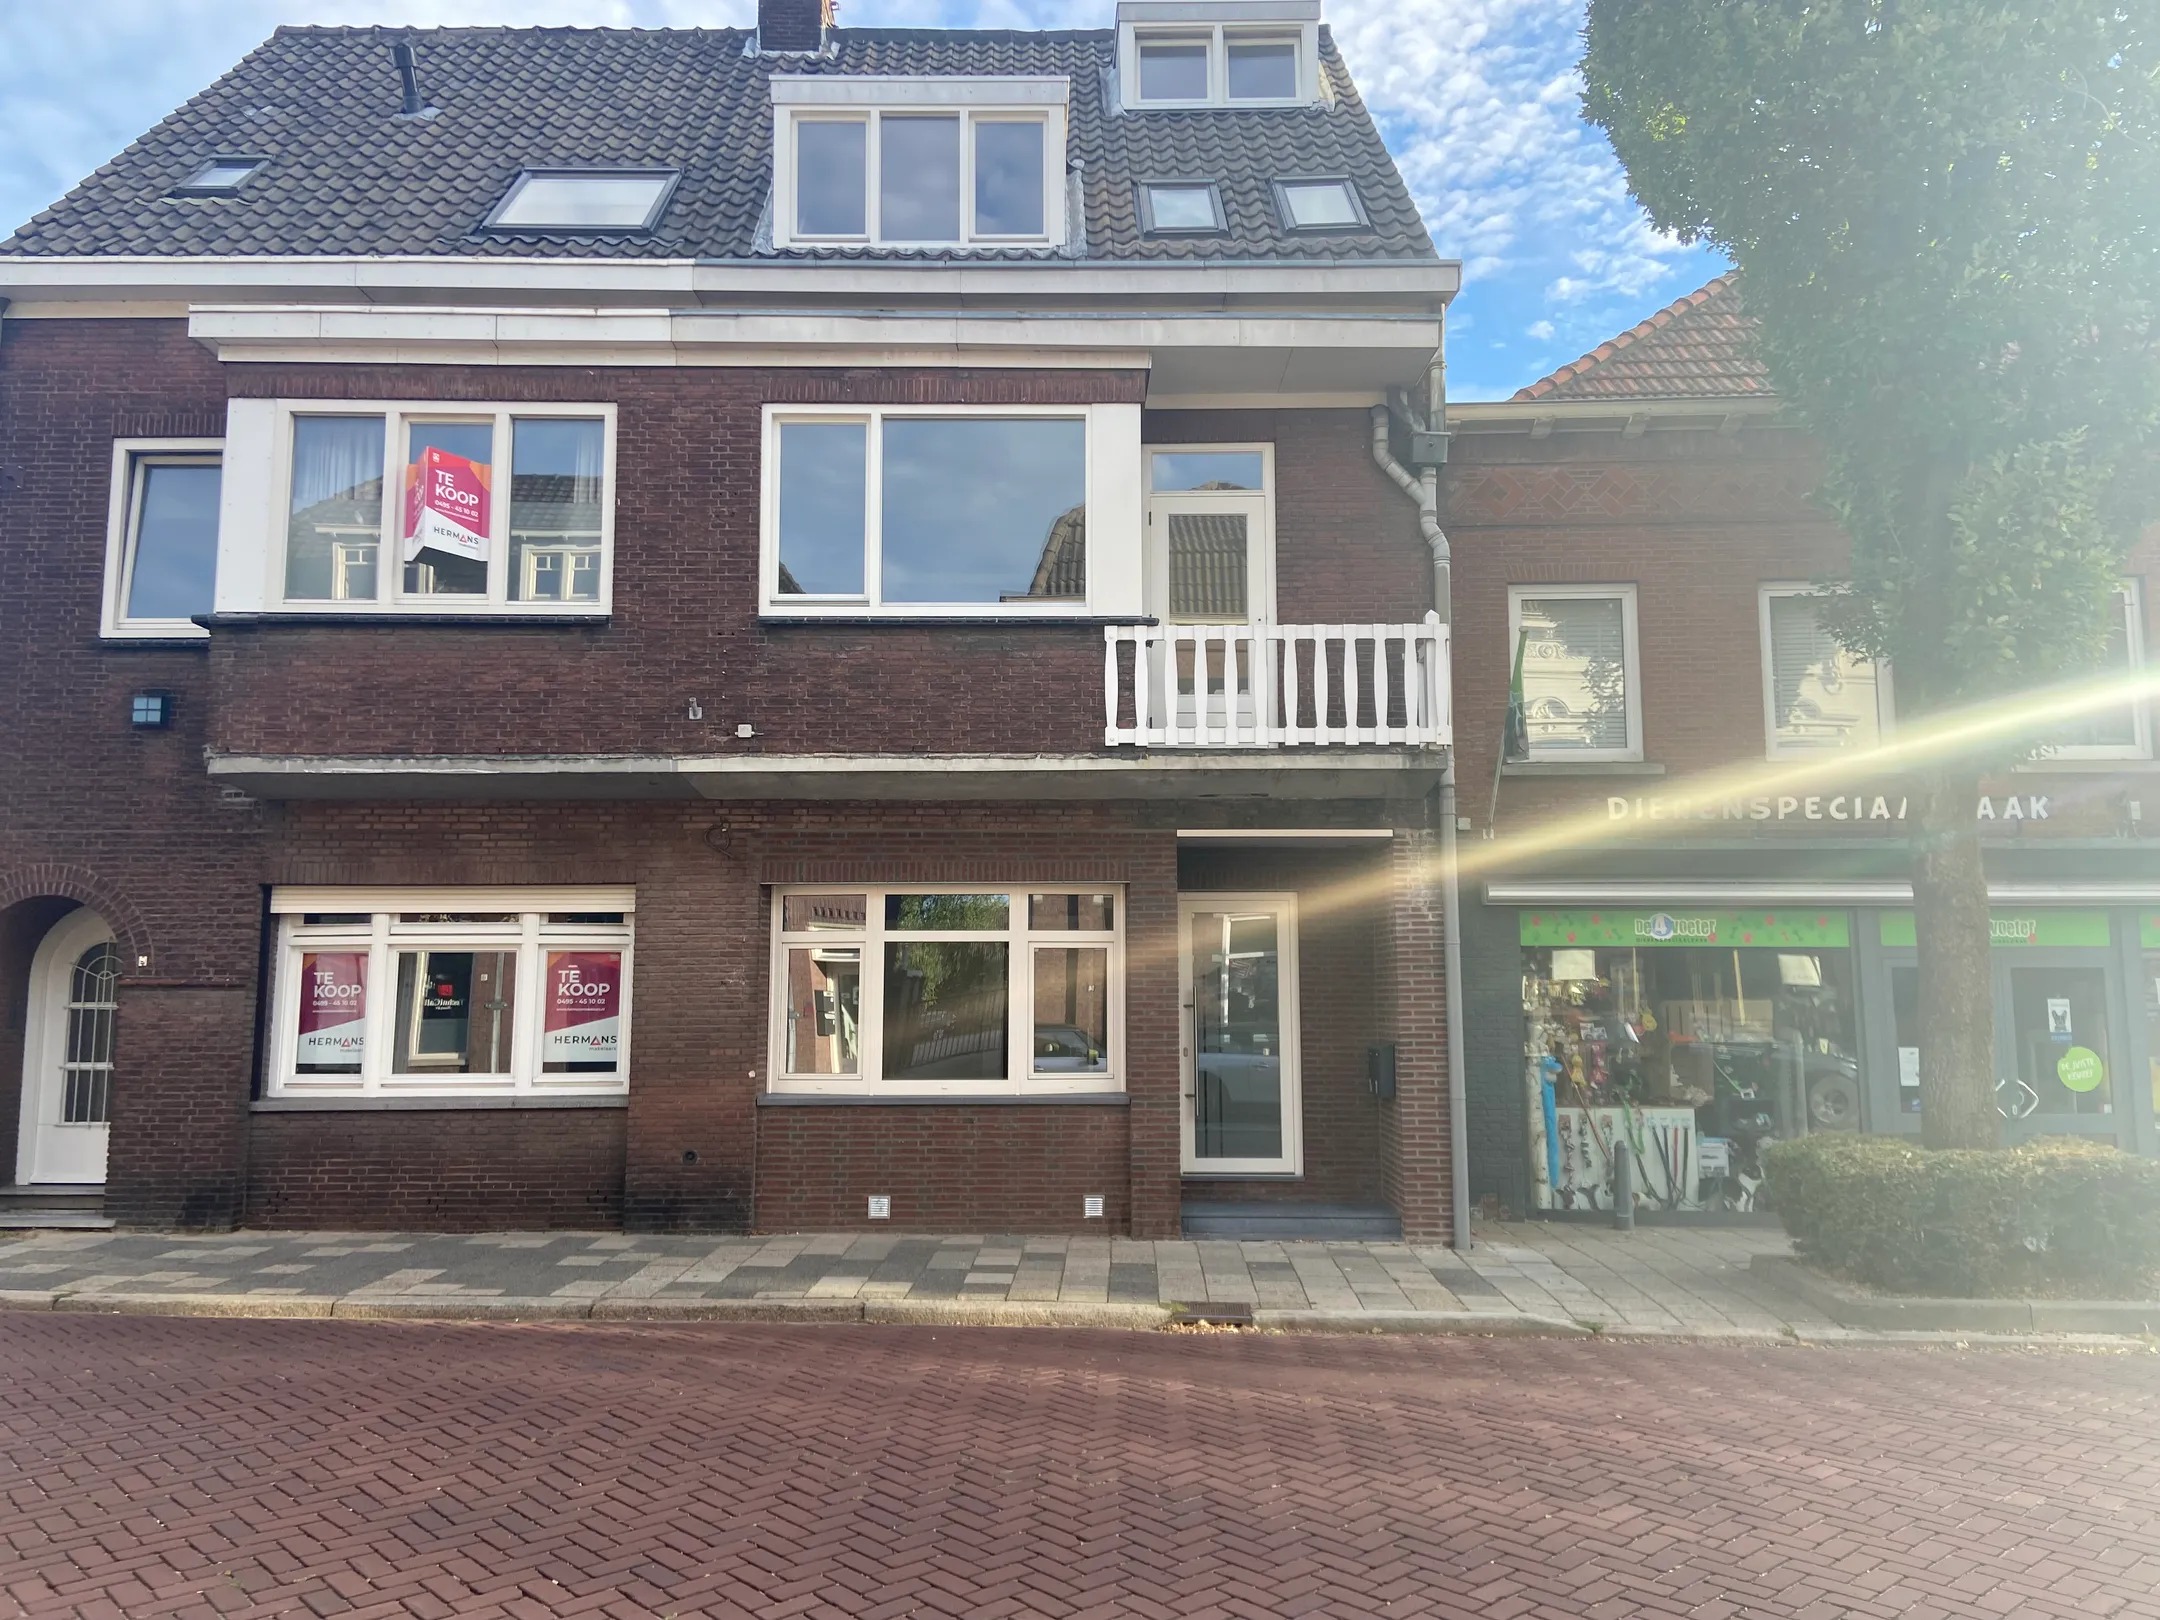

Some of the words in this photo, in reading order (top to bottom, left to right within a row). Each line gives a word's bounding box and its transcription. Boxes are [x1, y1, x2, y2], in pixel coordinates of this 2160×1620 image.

[435, 469, 454, 487] TE
[435, 483, 479, 506] KOOP
[433, 526, 479, 545] HERMANS
[1607, 795, 2049, 820] DIERENSPECIAAAK
[314, 972, 334, 985] TE
[558, 970, 580, 983] TE
[314, 985, 362, 998] KOOP
[558, 983, 611, 996] KOOP
[308, 1037, 364, 1047] HERMANS
[554, 1035, 618, 1046] HERMANS
